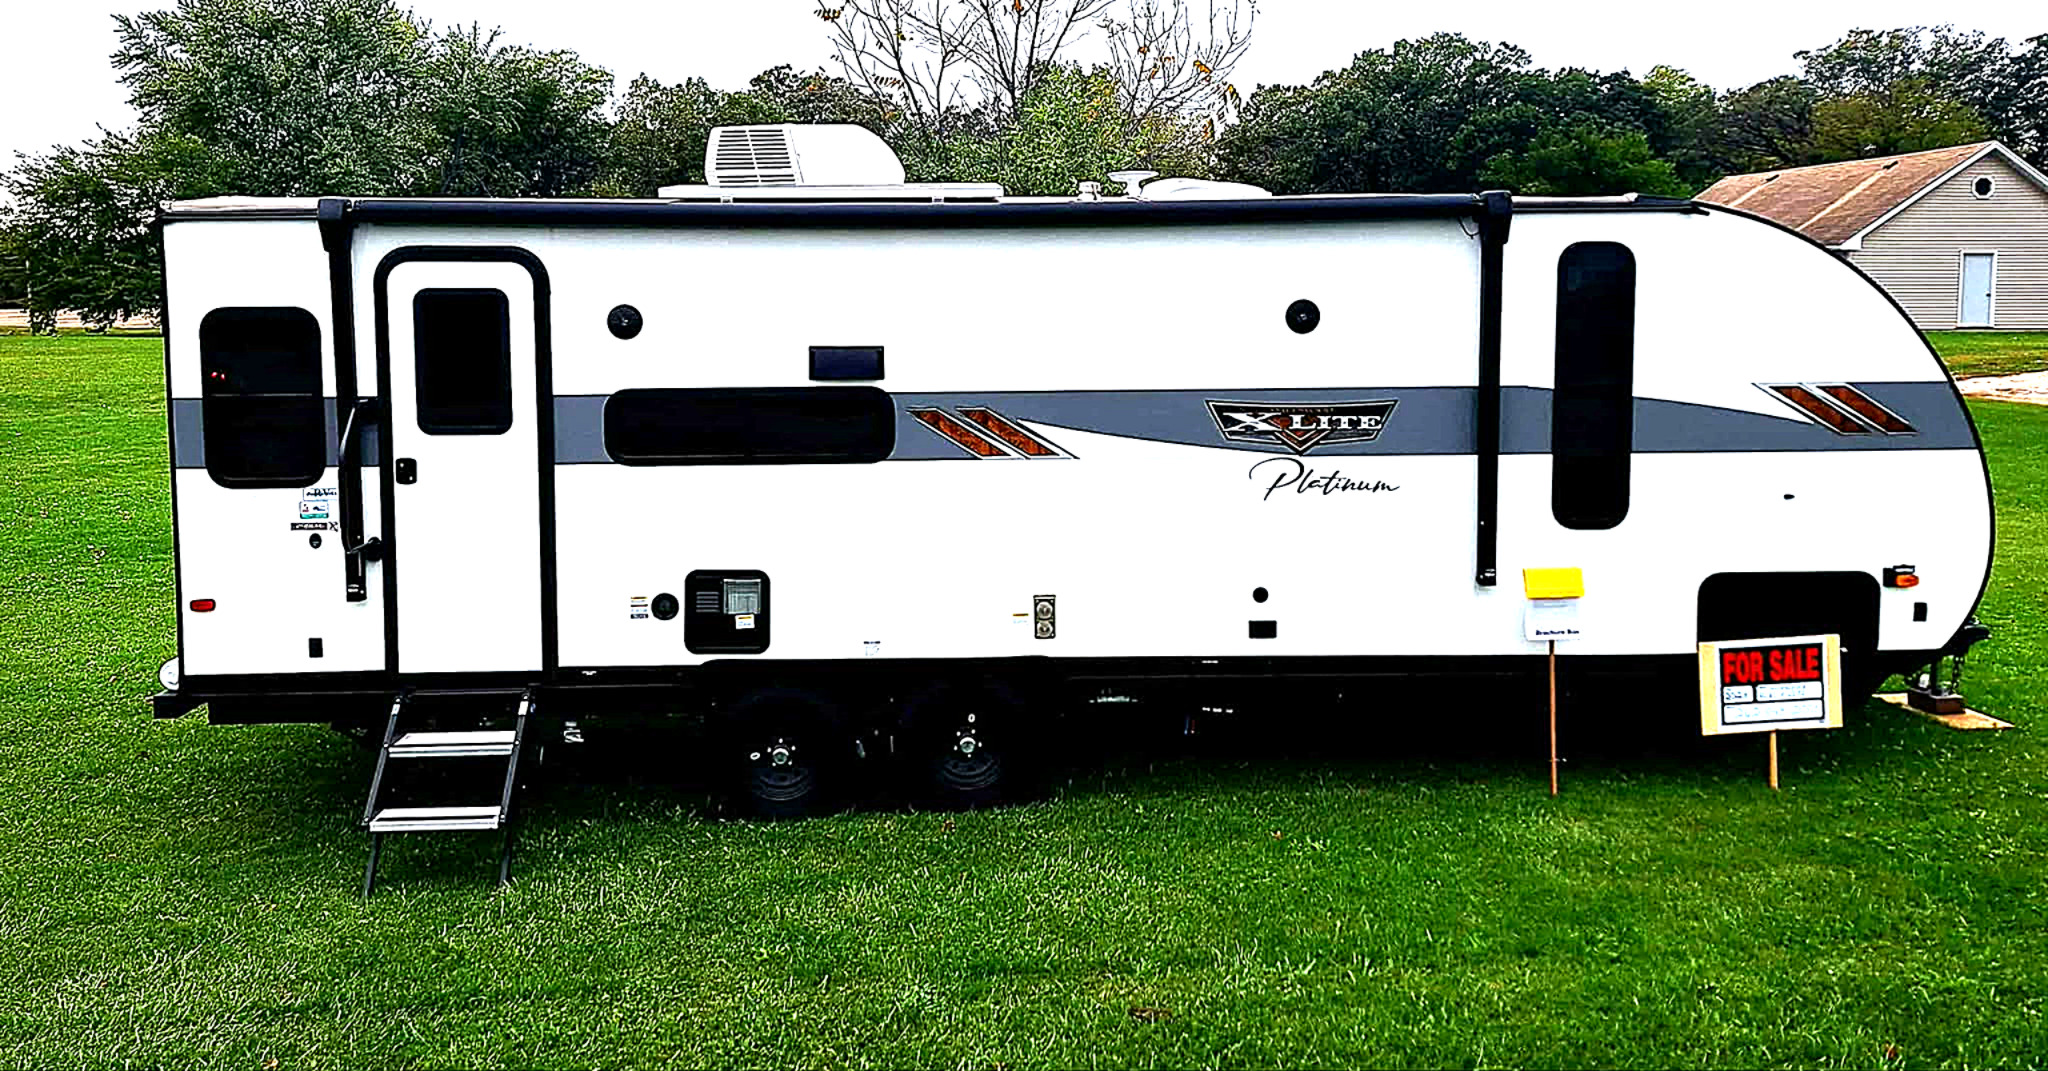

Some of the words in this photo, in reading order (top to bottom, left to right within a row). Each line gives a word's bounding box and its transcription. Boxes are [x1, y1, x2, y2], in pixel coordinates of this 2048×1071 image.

[1289, 414, 1382, 430] LITE
[1249, 457, 1400, 501] Platinum
[1722, 650, 1764, 684] FOR
[1768, 647, 1820, 681] SALE
